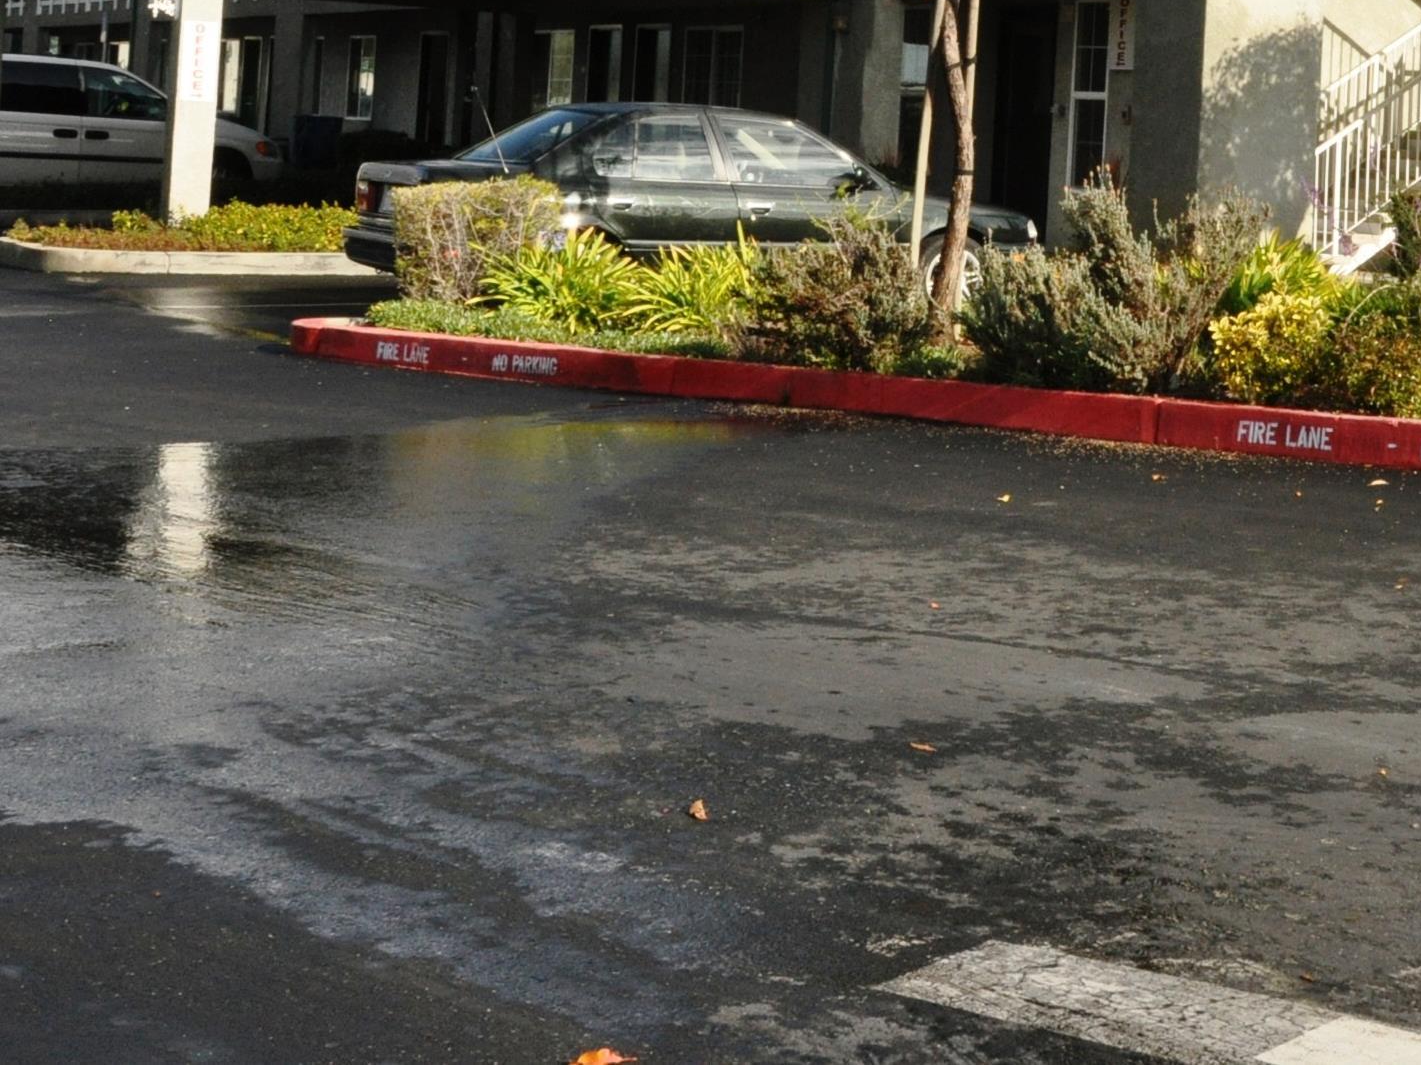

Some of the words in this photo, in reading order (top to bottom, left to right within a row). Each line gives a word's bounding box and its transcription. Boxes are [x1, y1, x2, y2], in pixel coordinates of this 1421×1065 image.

[192, 23, 206, 91] OFFICE
[376, 341, 400, 361] FIRE
[403, 342, 430, 364] LANE
[491, 353, 508, 371] NO
[511, 354, 558, 376] PARKING
[1236, 419, 1278, 446] FIRE
[1285, 425, 1333, 451] LANE
